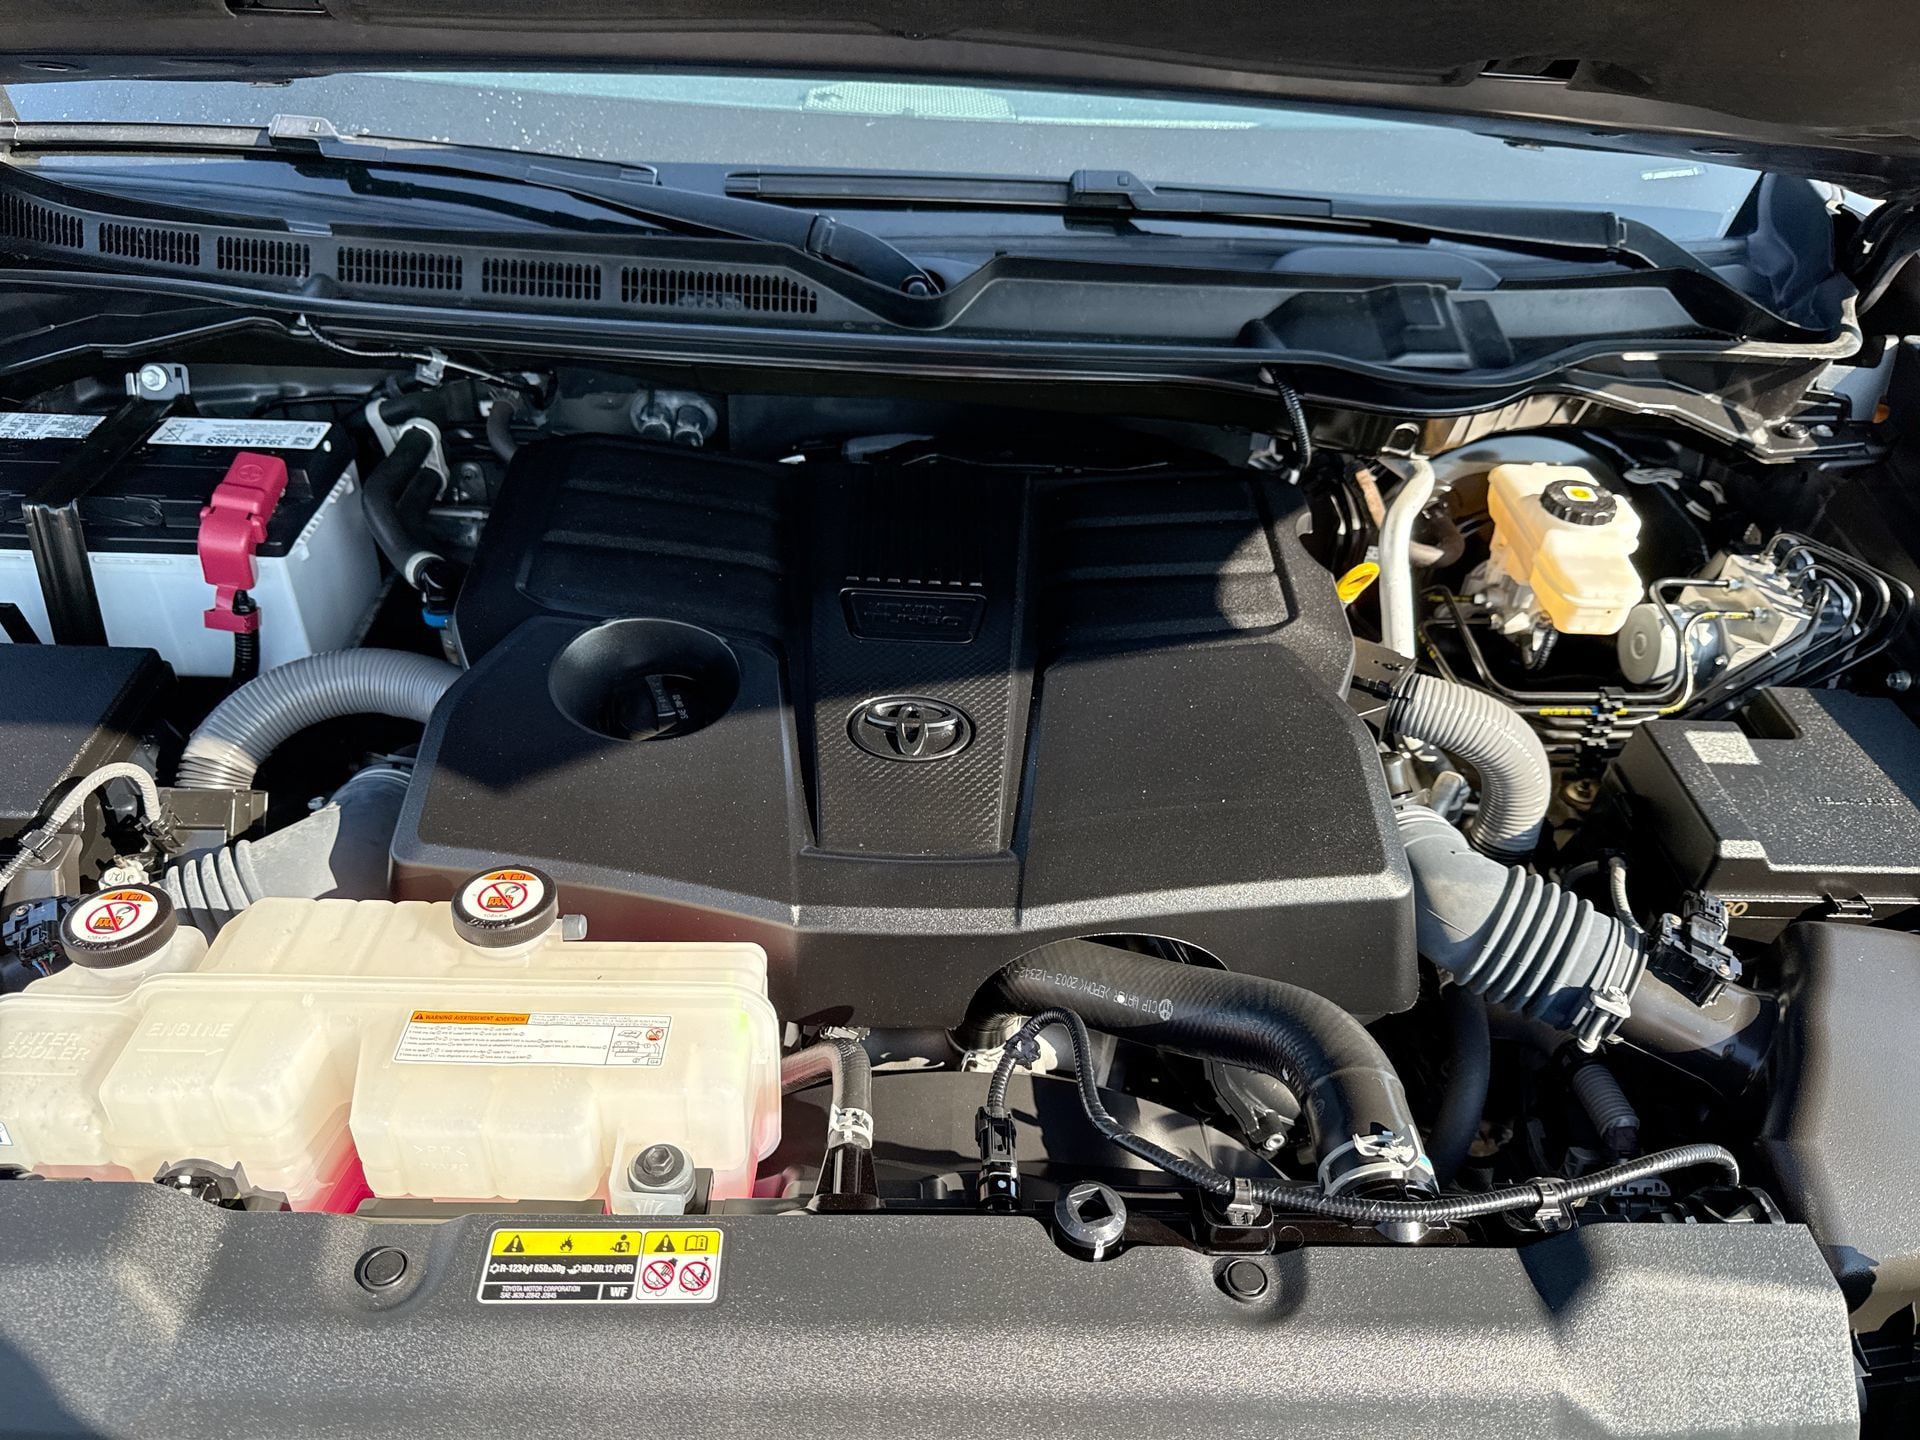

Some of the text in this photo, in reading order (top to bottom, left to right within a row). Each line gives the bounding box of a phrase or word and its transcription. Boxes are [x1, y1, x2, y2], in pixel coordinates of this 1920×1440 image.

[146, 1022, 234, 1037] ENGINE
[8, 1032, 81, 1046] INTER
[2, 1046, 91, 1060] COOLER
[609, 1287, 628, 1297] WF
